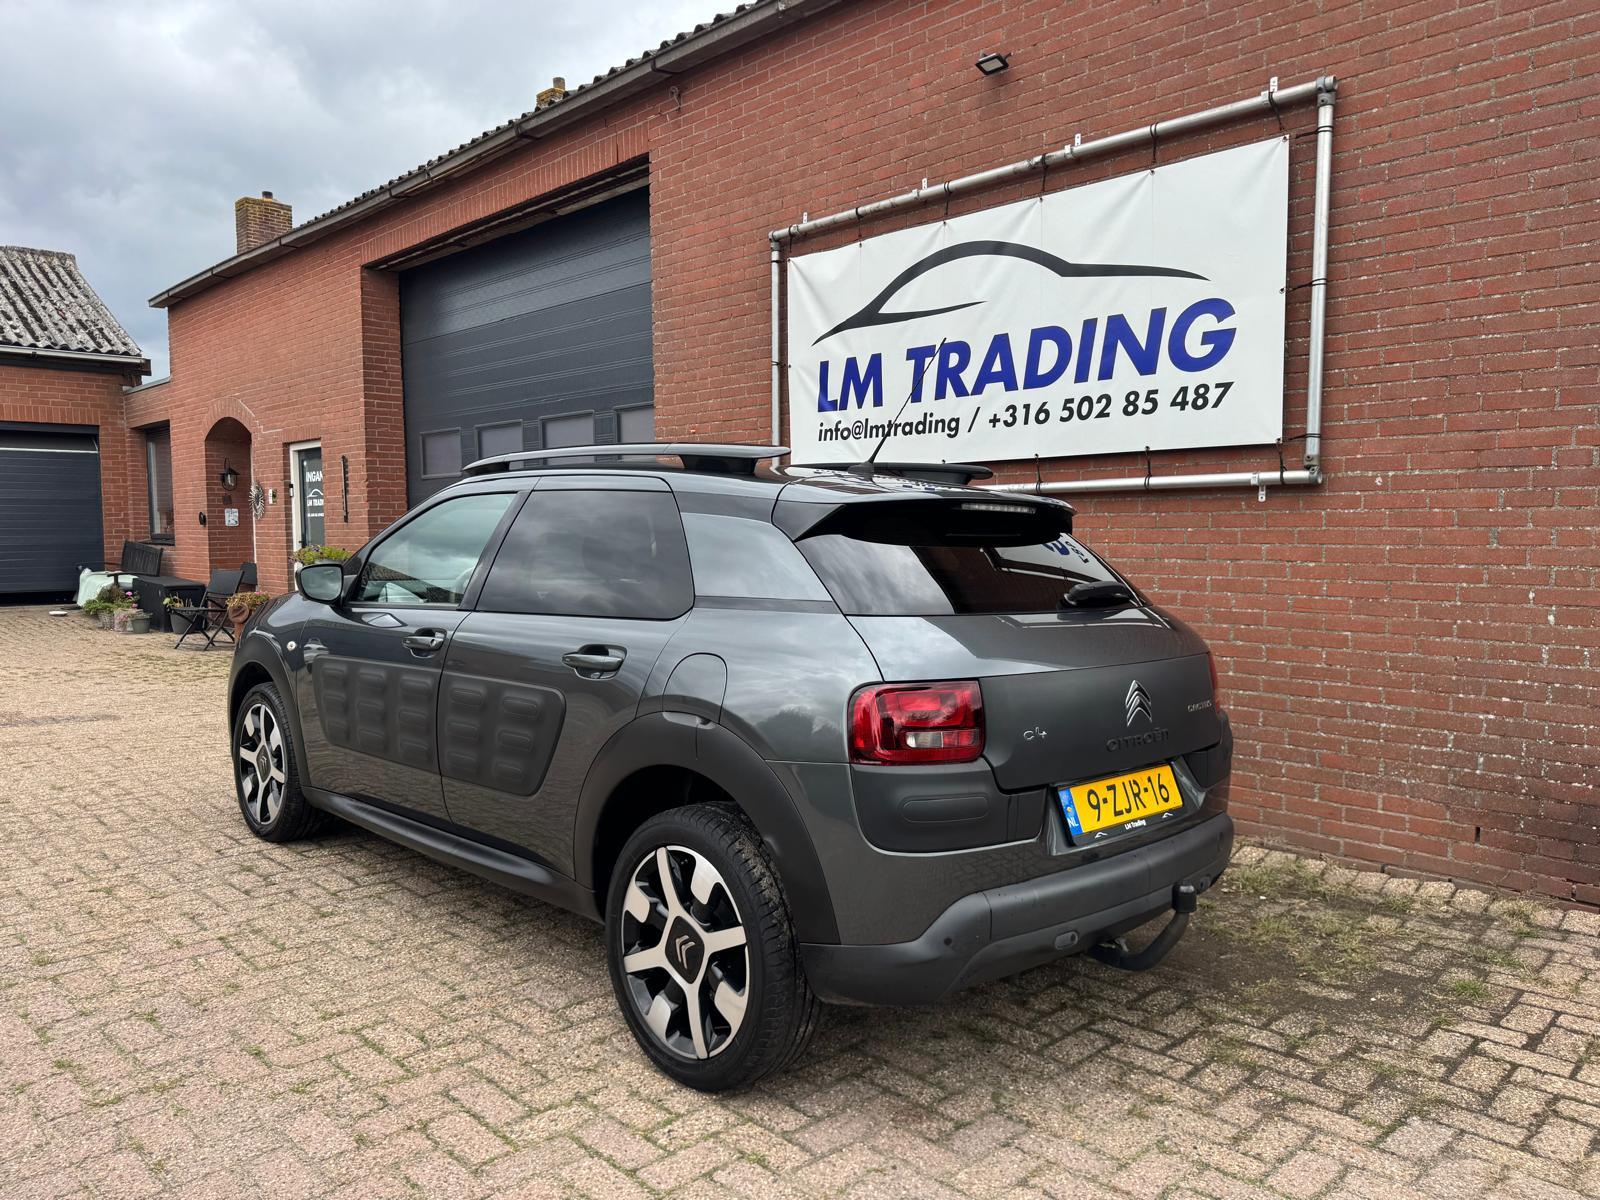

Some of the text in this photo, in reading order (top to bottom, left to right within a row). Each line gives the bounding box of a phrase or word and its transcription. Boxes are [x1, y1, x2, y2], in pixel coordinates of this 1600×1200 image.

[817, 297, 1237, 413] LM TRADING
[818, 381, 1235, 442] info@lmtrading / +316 502 85 487
[1087, 773, 1170, 822] 9-ZJR-16
[1067, 817, 1079, 828] NL
[1132, 819, 1146, 828] Trading
